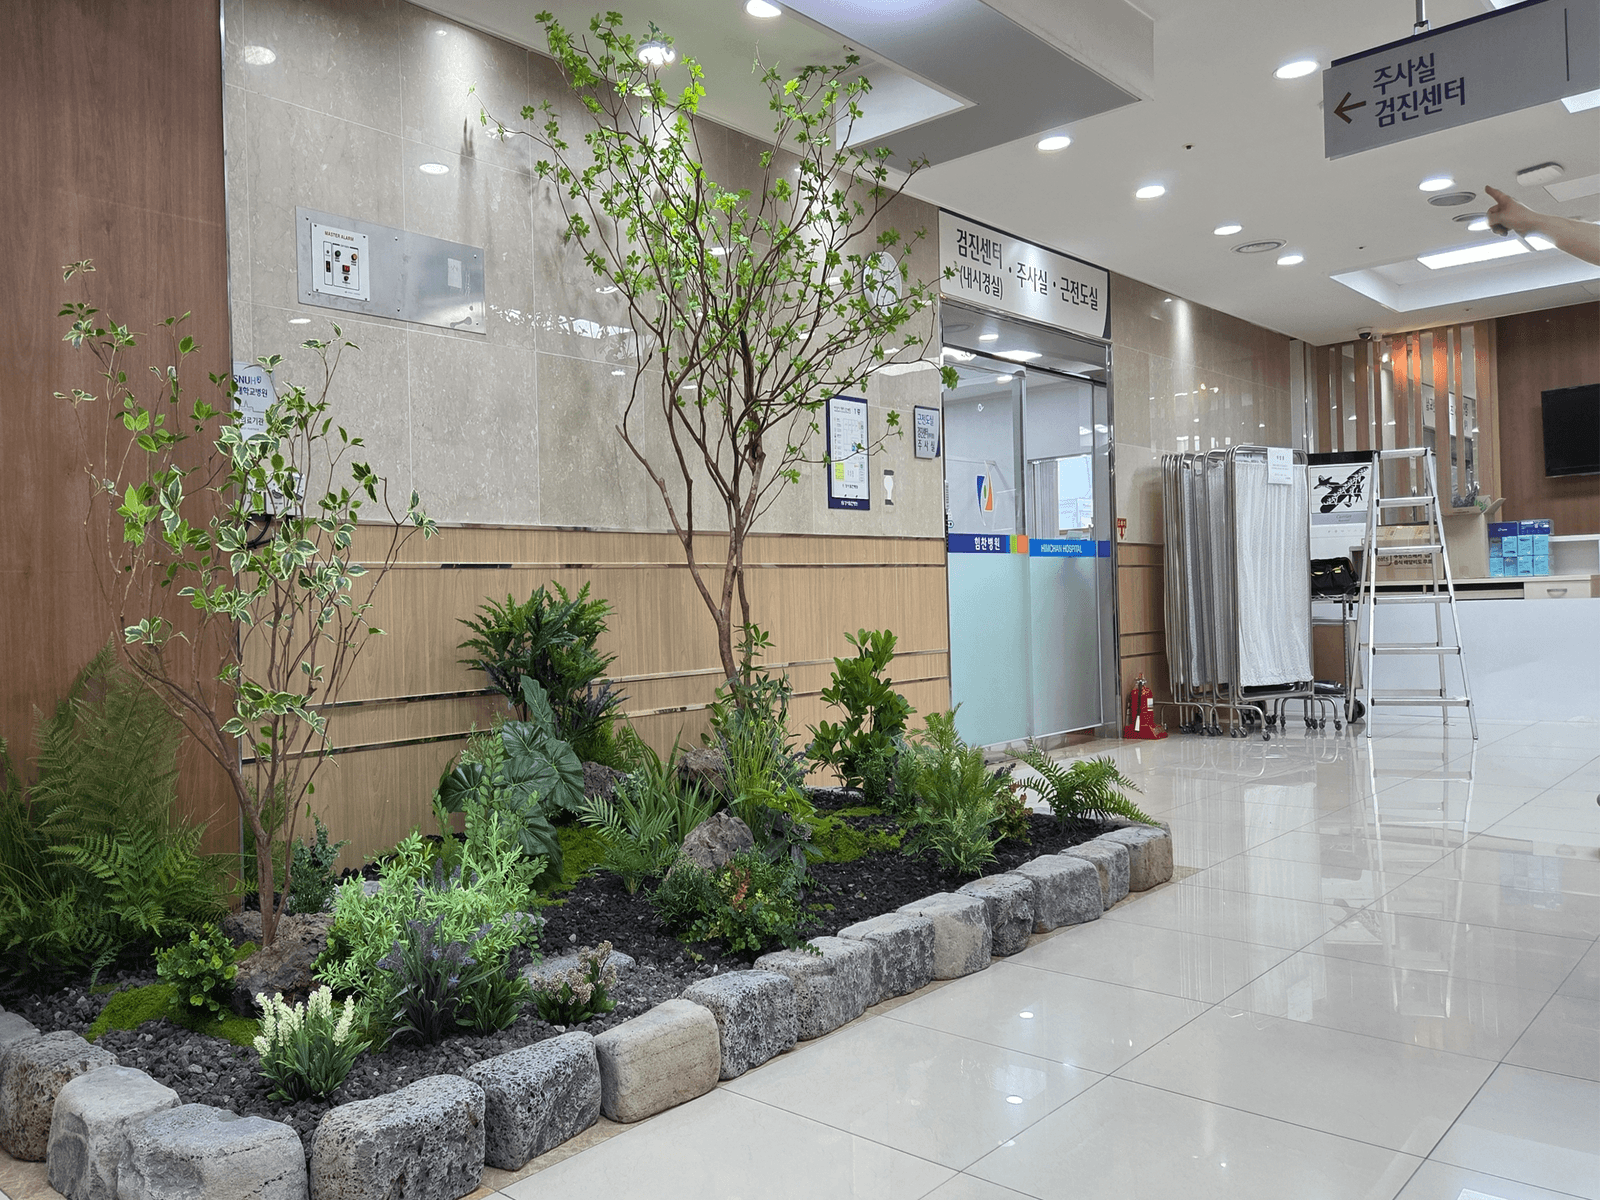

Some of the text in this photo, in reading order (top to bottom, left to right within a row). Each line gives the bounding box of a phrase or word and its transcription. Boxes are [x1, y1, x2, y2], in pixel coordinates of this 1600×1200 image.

[1373, 53, 1436, 95] 주사실
[1375, 77, 1466, 127] 검진센터
[324, 230, 340, 238] MASTER
[956, 228, 1003, 269] 검진센터
[959, 265, 1003, 300] (내시경실)
[1016, 262, 1098, 311] 주사실 근전도실
[974, 536, 1000, 551] 힘찬병원
